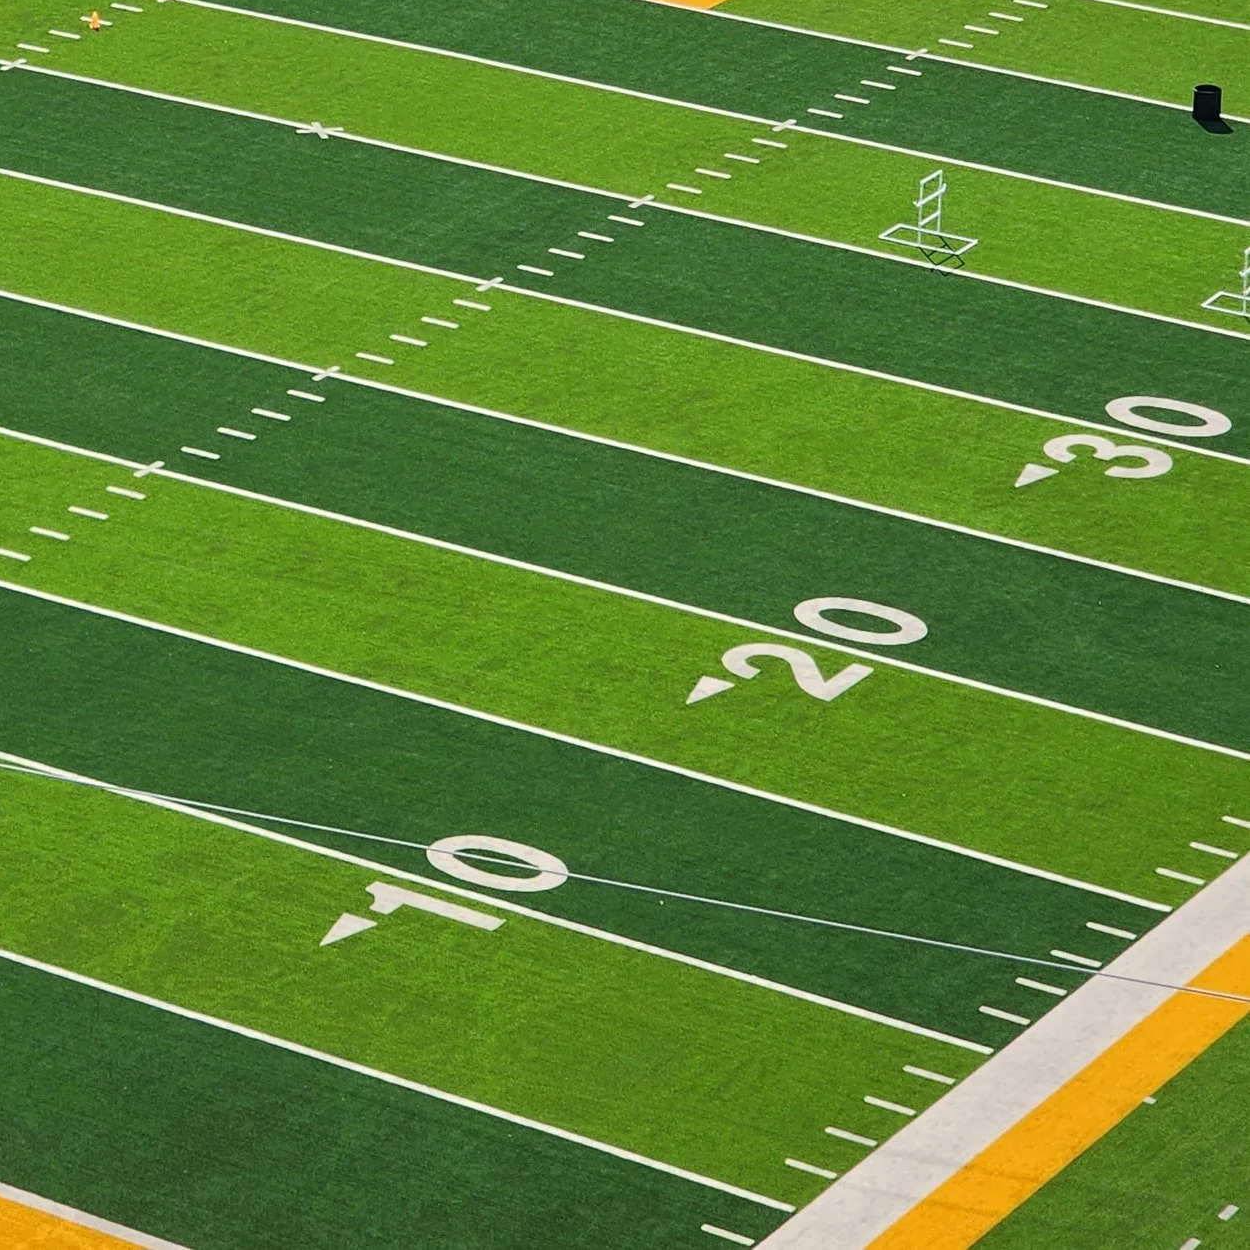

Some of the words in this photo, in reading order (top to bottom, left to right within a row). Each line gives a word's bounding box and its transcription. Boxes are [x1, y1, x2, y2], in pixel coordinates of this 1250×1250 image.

[1043, 395, 1232, 480] 30
[720, 596, 928, 702] 20
[365, 834, 569, 931] 10
